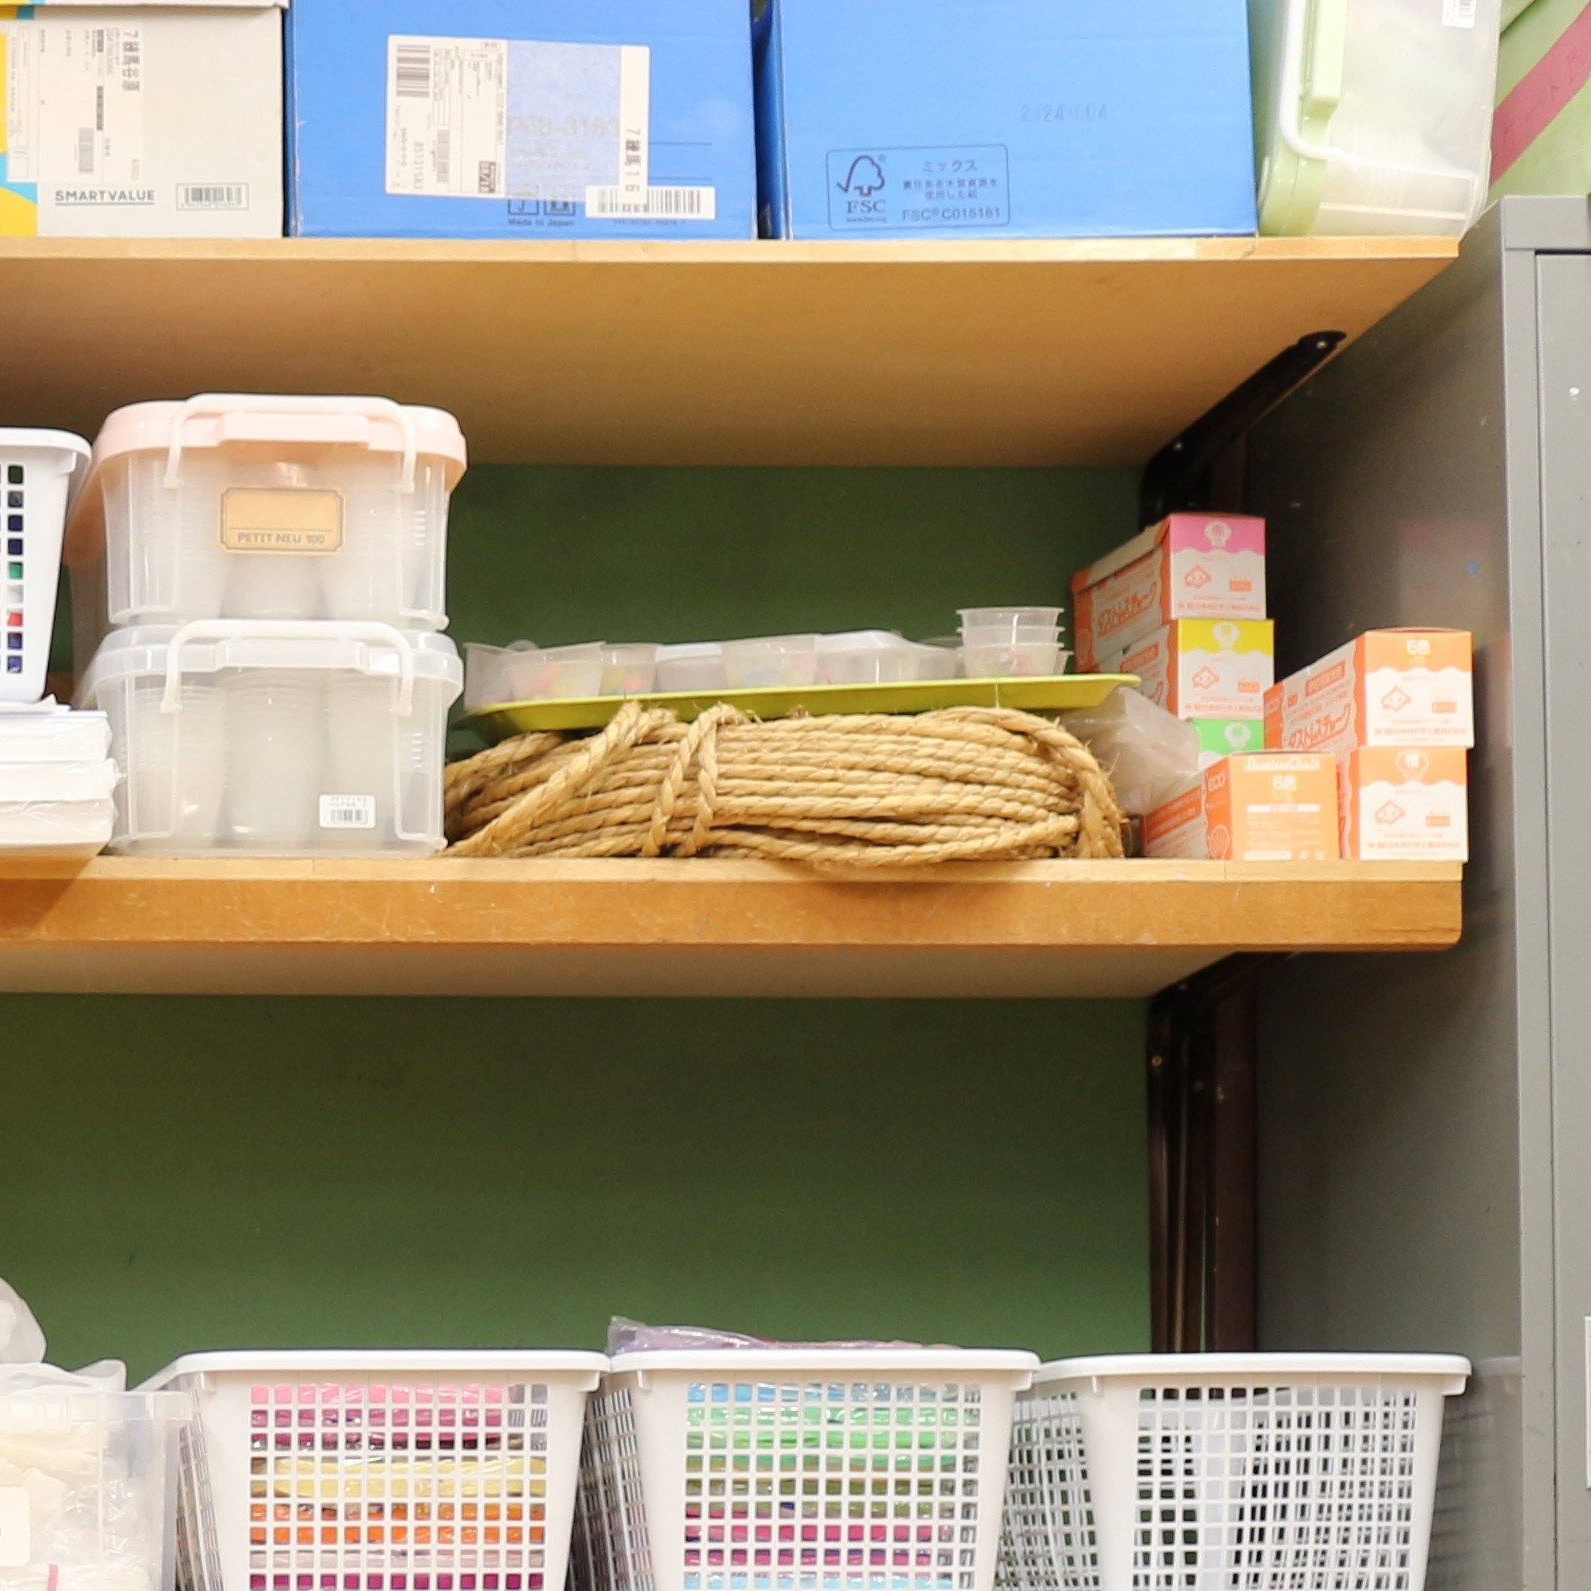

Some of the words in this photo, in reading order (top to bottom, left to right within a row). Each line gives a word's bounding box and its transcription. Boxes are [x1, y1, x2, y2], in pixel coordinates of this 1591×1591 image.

[922, 160, 979, 173] ミックス
[846, 200, 887, 213] FSC
[238, 531, 272, 543] PETIT
[276, 533, 302, 544] NEU
[306, 533, 326, 545] 100
